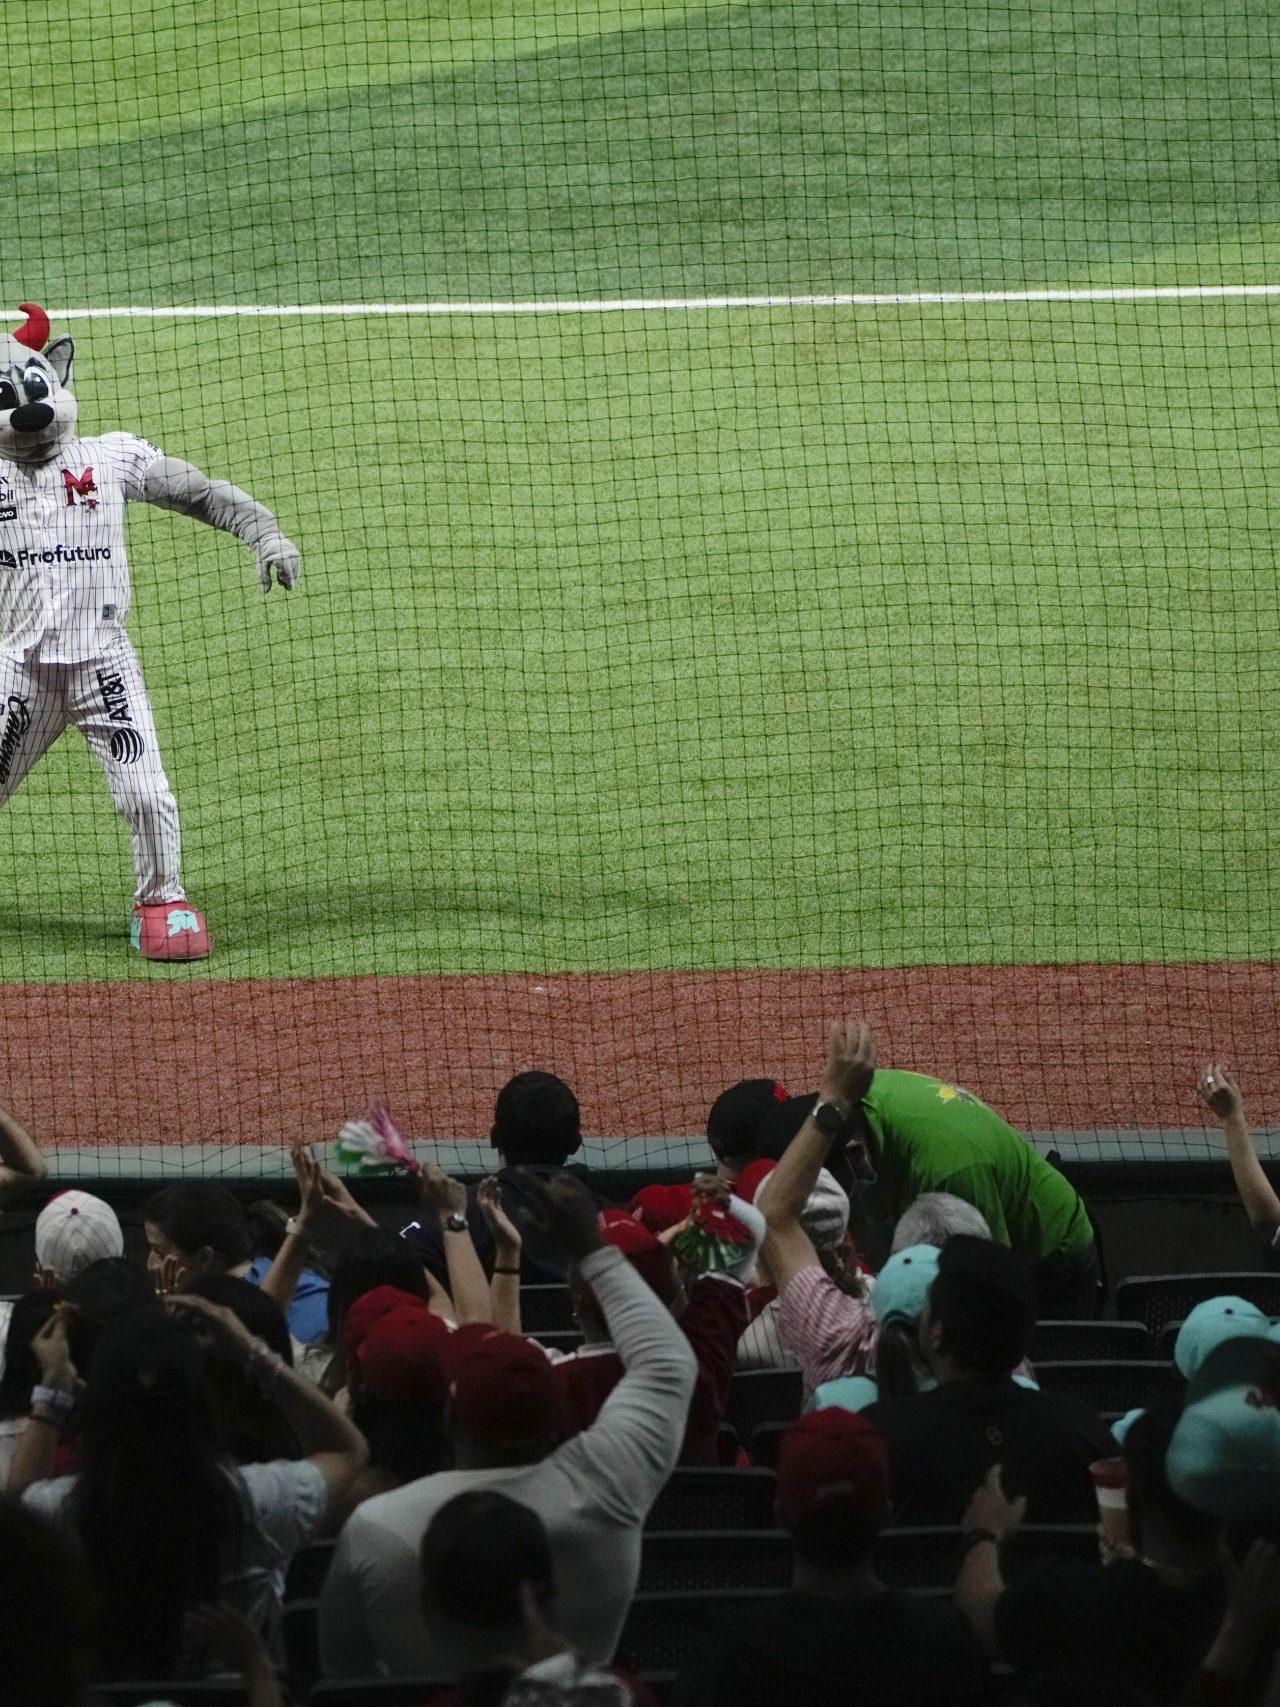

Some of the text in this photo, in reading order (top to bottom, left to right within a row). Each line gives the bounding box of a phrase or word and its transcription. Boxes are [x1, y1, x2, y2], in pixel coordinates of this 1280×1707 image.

[61, 467, 93, 506] M
[18, 545, 111, 567] Profuturo
[96, 669, 132, 721] AT&T
